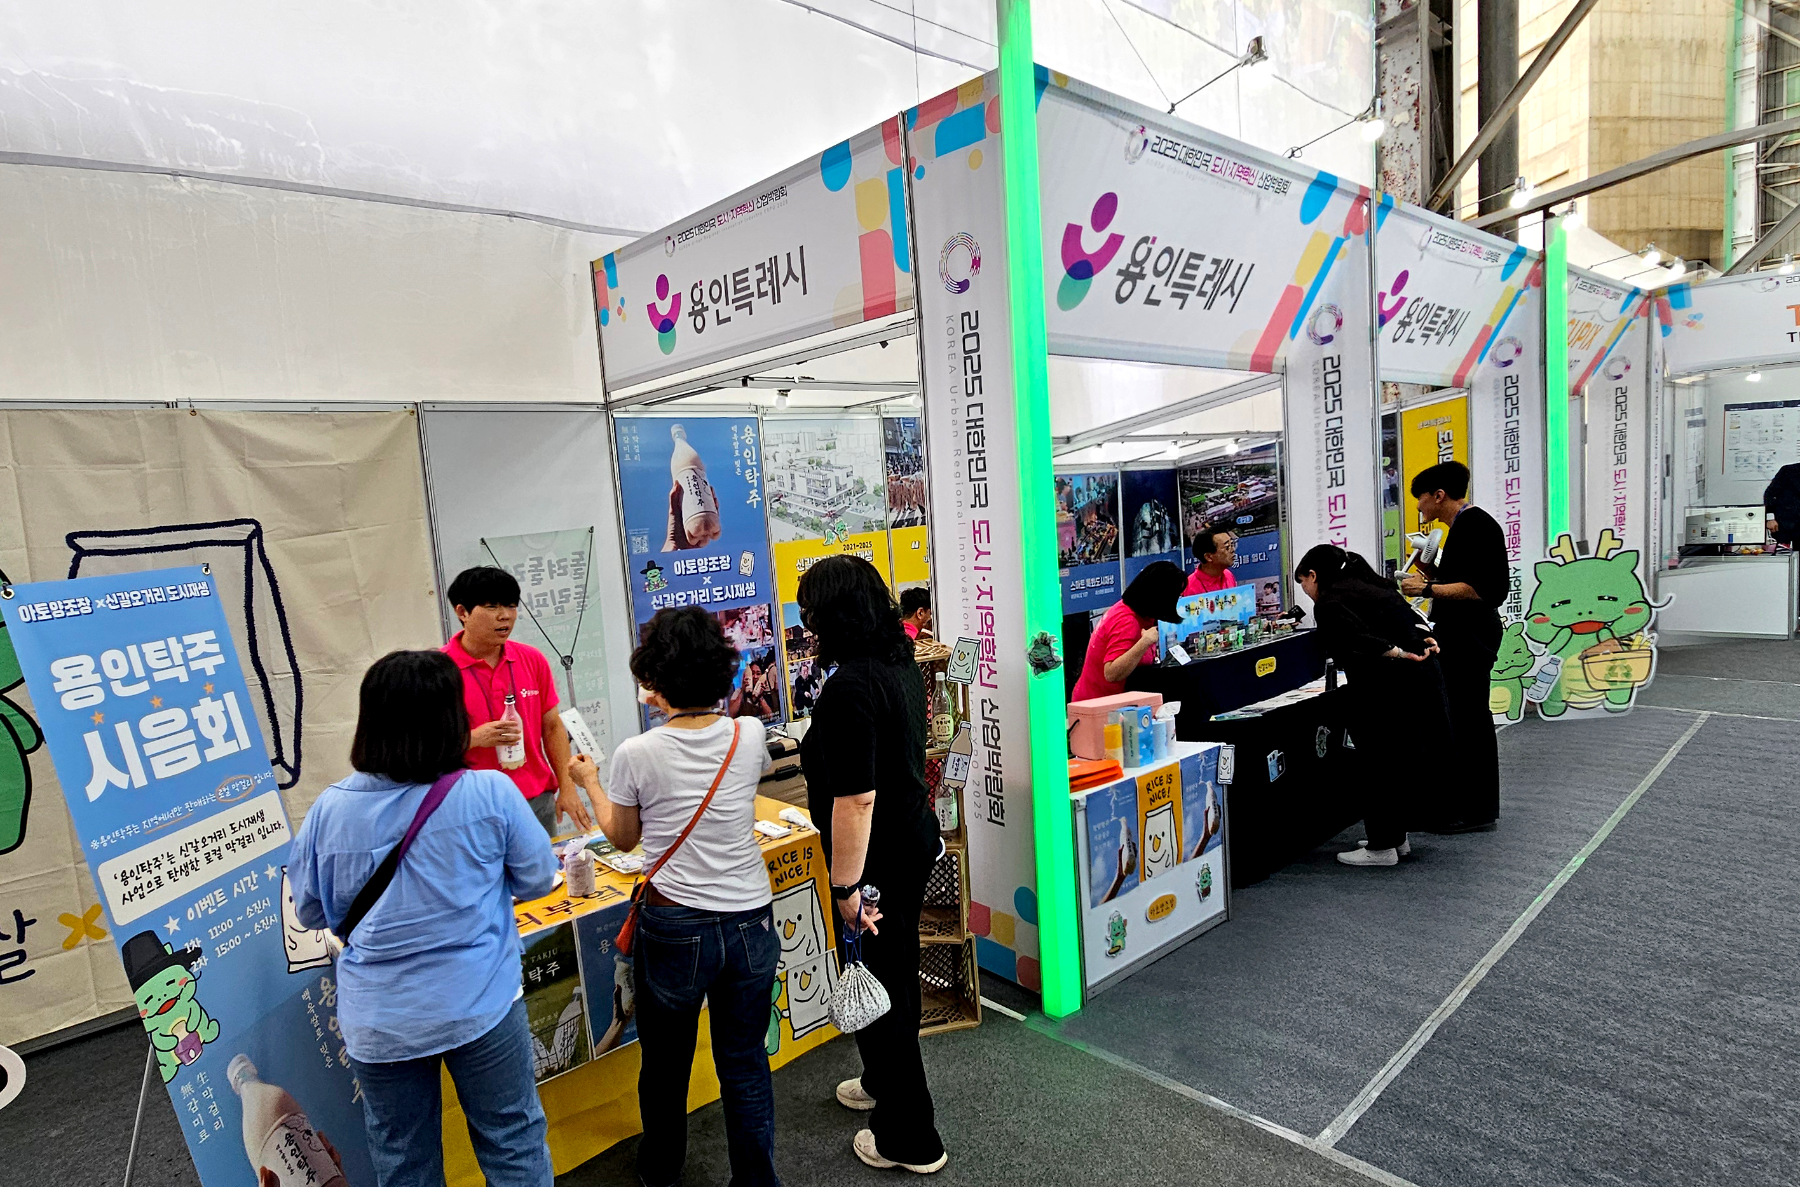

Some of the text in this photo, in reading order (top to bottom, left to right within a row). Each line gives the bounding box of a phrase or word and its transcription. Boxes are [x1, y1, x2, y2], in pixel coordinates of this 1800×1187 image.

[1150, 135, 1180, 160] 2025
[1178, 144, 1212, 172] 대한민국
[1257, 172, 1292, 196] 산업박람회
[678, 228, 694, 244] 2025
[694, 218, 716, 236] 대한민국
[756, 185, 788, 209] 산업박람회
[688, 245, 808, 334] 용인특례시
[1115, 236, 1255, 314] 용인특례시
[1392, 297, 1471, 346] 용인특례시
[961, 310, 984, 398] 2025
[1322, 354, 1342, 414] 2025
[1504, 374, 1519, 419] 2025
[1615, 386, 1628, 422] 2025
[740, 424, 761, 508] 용인탁주
[966, 402, 989, 509] 대한민국
[1325, 416, 1345, 488] 대한민국
[1504, 420, 1520, 474] 대한민국
[1613, 422, 1628, 466] 대한민국
[946, 314, 970, 631] KOREA Urban Regional Innovation
[674, 555, 732, 576] 아토양조장
[843, 541, 872, 551] 2021-2025
[18, 597, 94, 622] 아토양조장
[105, 586, 166, 610] 신갈오거리
[166, 581, 210, 602] 도시재생
[651, 582, 756, 610] 신갈오거리 도시재생
[1507, 566, 1522, 621] 산업박람
[50, 630, 225, 710] 용인탁주
[83, 691, 251, 802] 시음회
[981, 698, 1005, 827] 산업박람회
[142, 806, 182, 830] 지역에서만
[184, 793, 216, 812] 판매하는
[218, 785, 232, 798] 로컬
[232, 778, 252, 792] 막걸리
[254, 771, 274, 784] 입니다.
[972, 780, 982, 820] 2025
[1146, 774, 1173, 794] RICE IS
[1150, 787, 1171, 805] NICE!
[180, 828, 226, 857] 신갈오거리
[229, 810, 266, 835] 도시재생
[768, 846, 813, 874] RICE IS
[122, 821, 284, 905] 사업으로 탄생한 로컬 막걸리 입니다.
[187, 870, 258, 920] 이벤트 시간
[184, 937, 202, 954] 1차
[208, 918, 234, 940] 11:00
[246, 897, 270, 918] 소진시
[190, 956, 208, 972] 2차
[214, 935, 242, 958] 15:00
[254, 914, 278, 935] 소진시
[530, 948, 558, 962] TAKJU
[302, 988, 333, 1068] 백옥쌀로 빚은
[285, 1133, 316, 1185] 용인탁주
